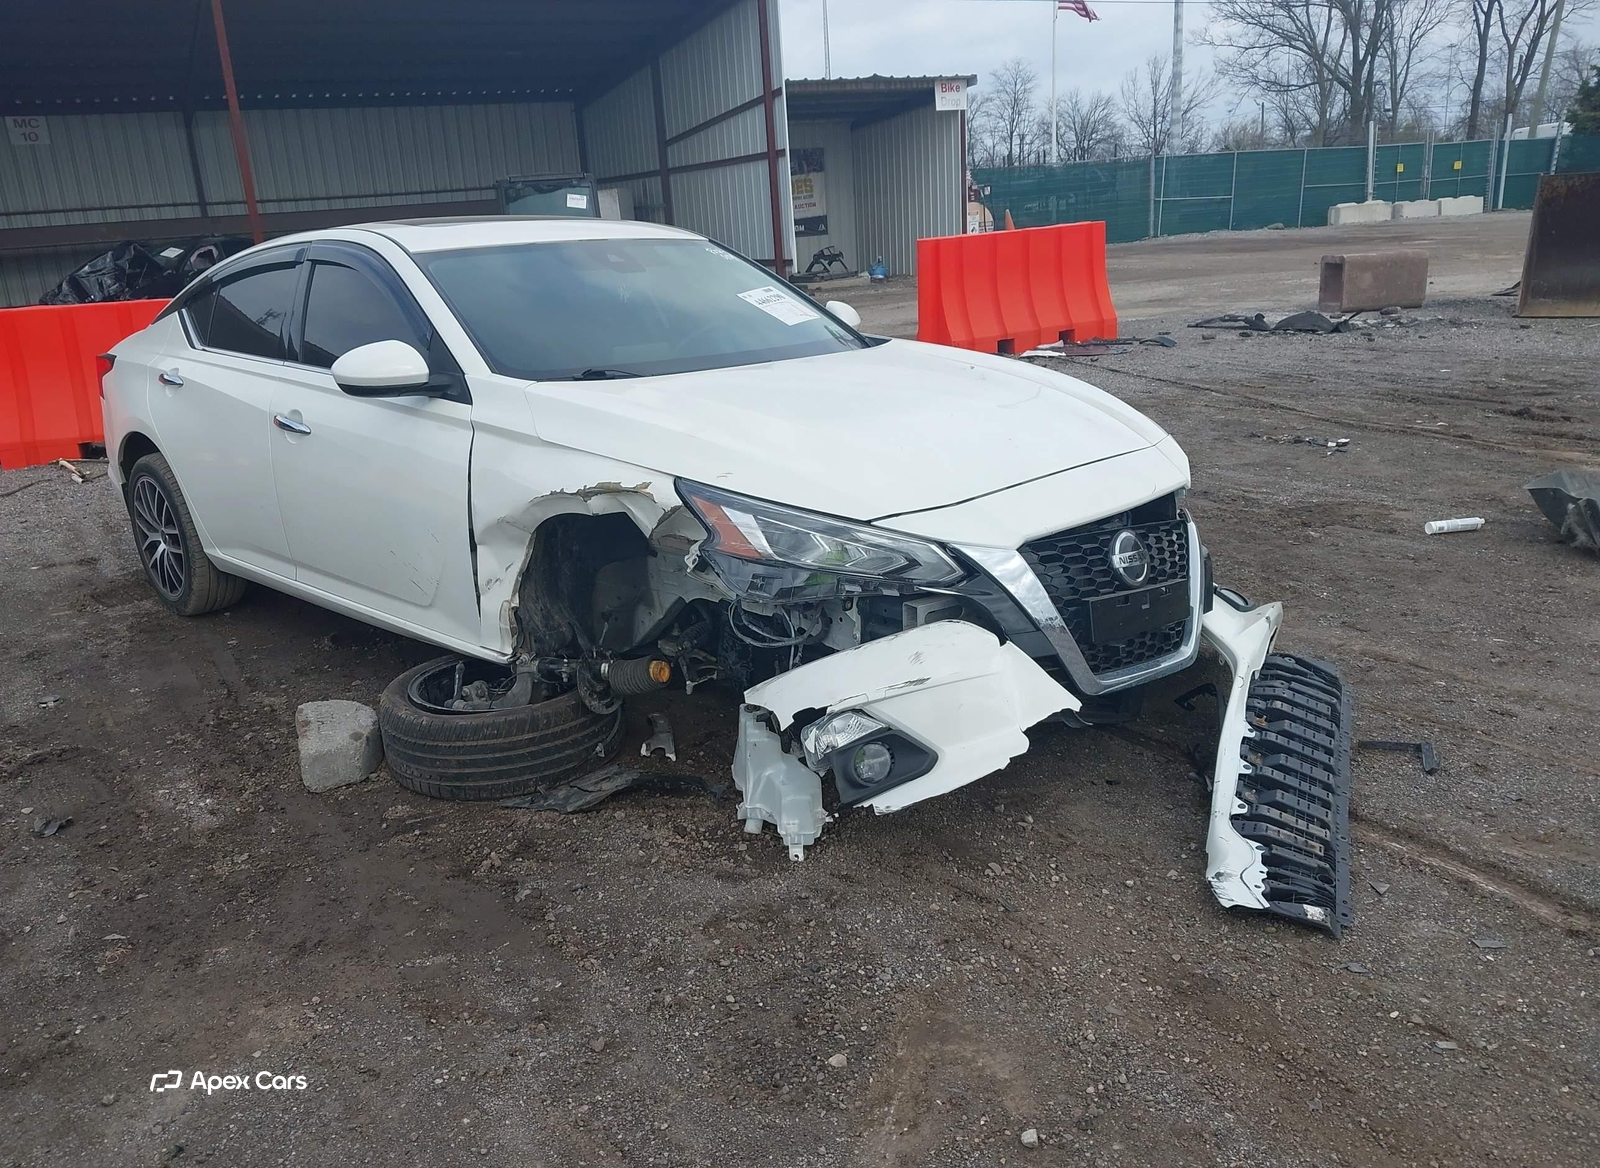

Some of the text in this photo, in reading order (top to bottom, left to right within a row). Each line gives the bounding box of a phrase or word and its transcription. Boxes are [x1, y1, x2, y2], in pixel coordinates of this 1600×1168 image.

[941, 82, 961, 93] Bike
[941, 96, 961, 108] Drop
[13, 118, 40, 129] MC
[20, 131, 39, 142] 10
[794, 201, 817, 210] AUCTION
[1119, 553, 1146, 565] NISS
